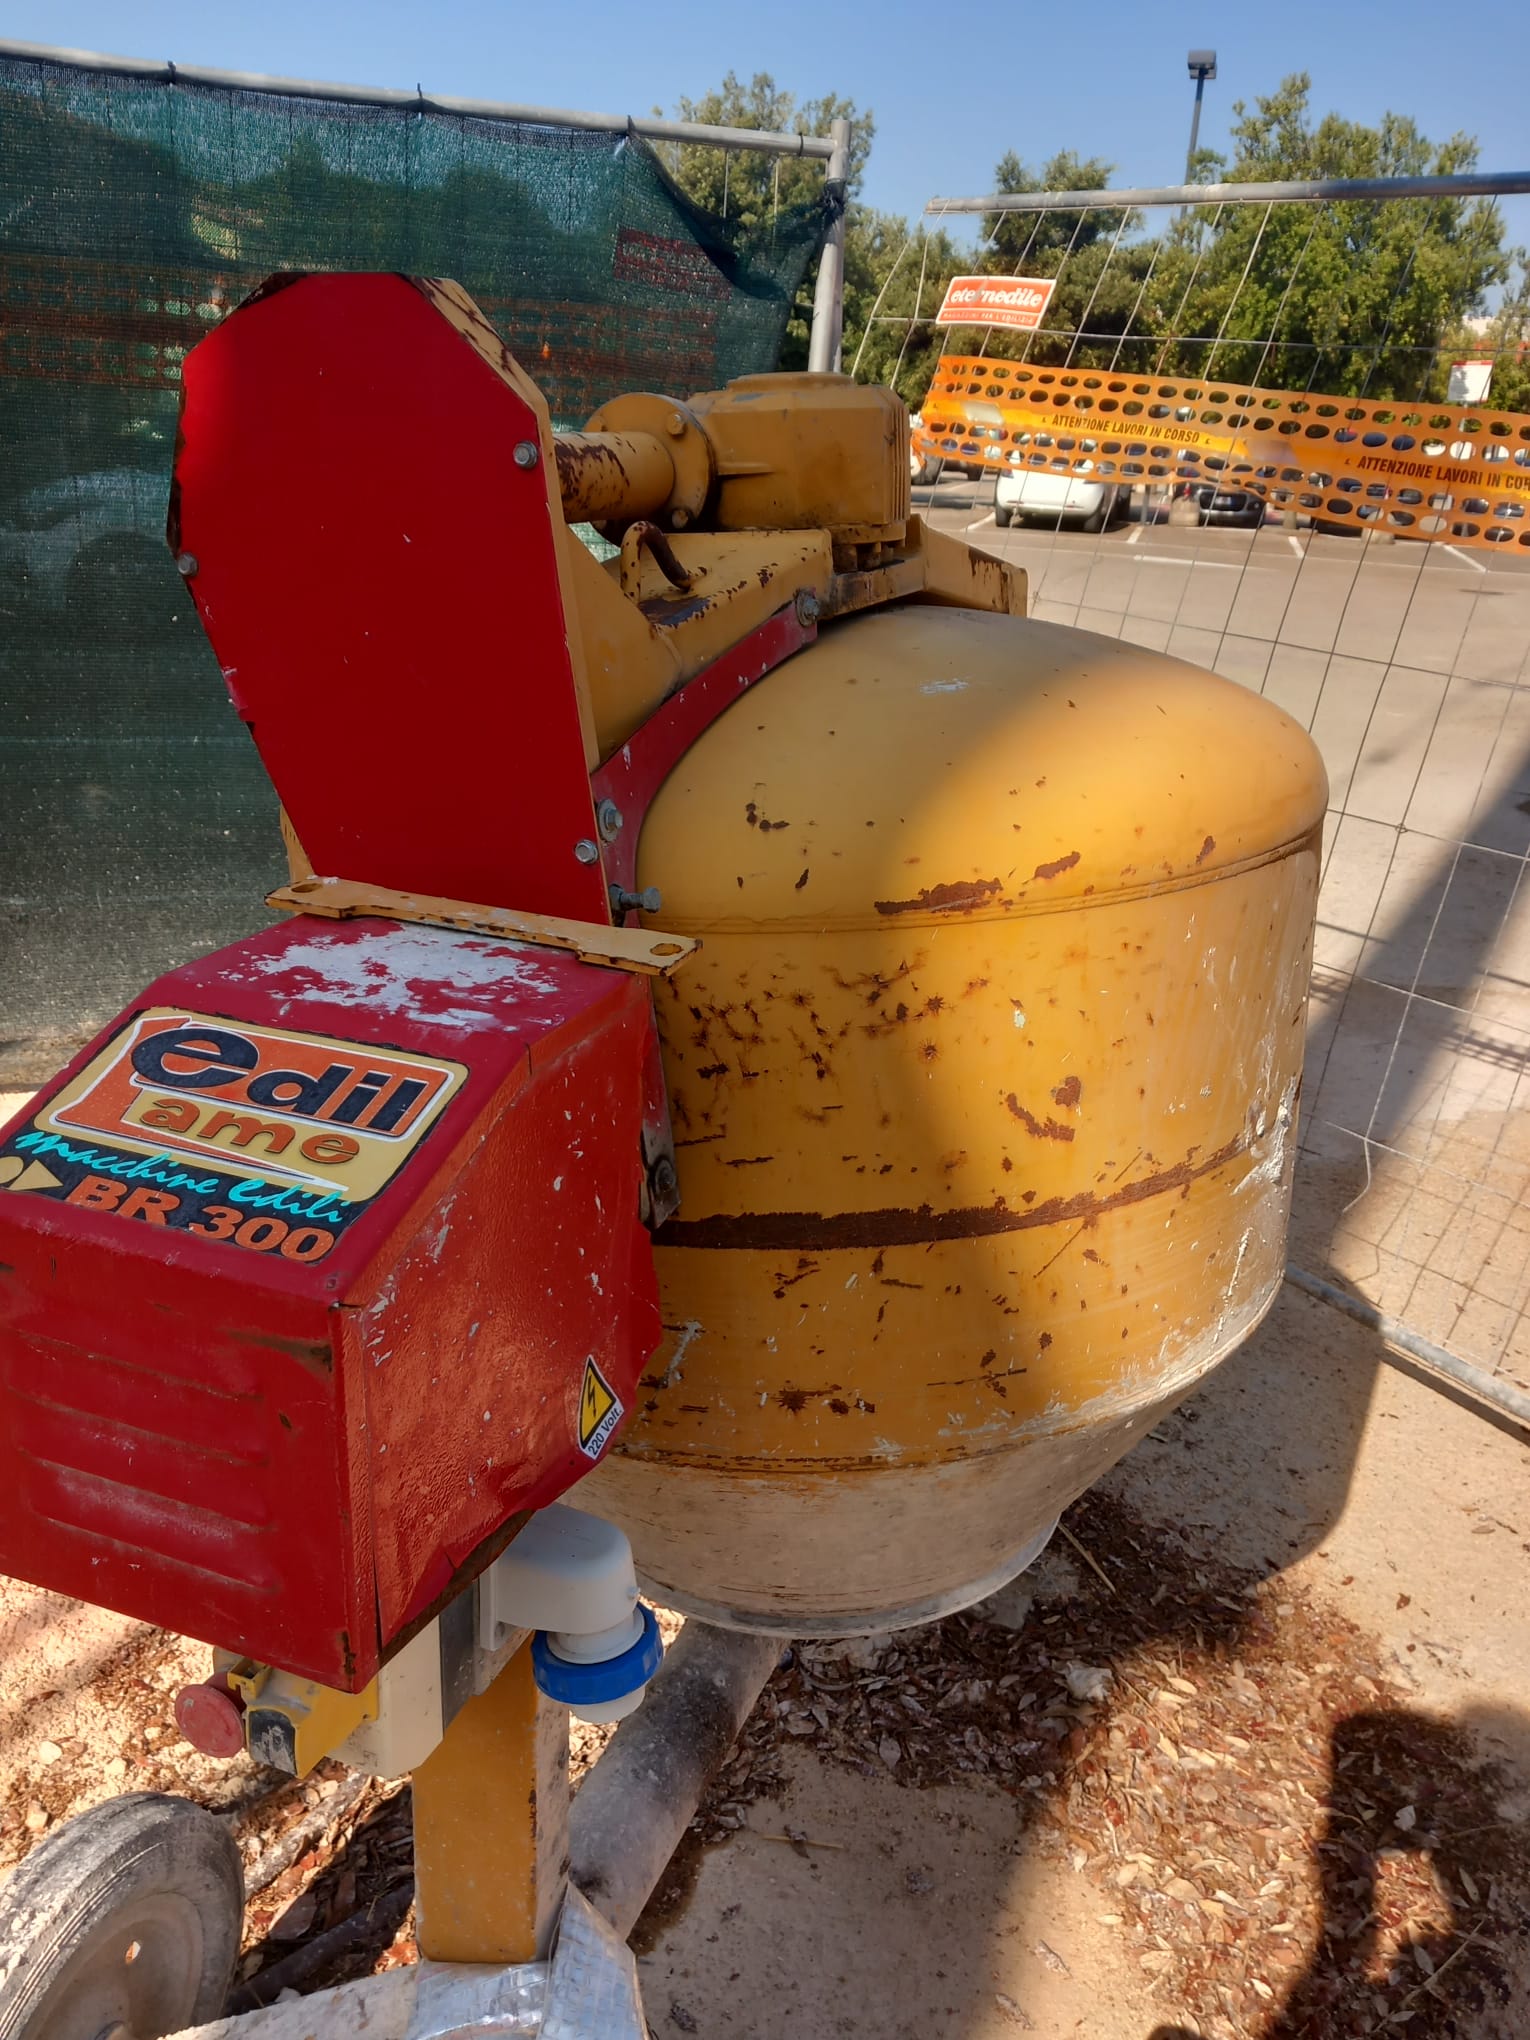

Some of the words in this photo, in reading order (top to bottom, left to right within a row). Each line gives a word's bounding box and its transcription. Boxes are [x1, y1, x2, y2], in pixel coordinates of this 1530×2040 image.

[1052, 414, 1109, 433] ATTENZIONE
[1112, 420, 1148, 436] LAVORI
[1150, 426, 1162, 438] IN
[1164, 428, 1201, 443] CORSO
[1357, 456, 1433, 479] ATTENZIONE
[1436, 467, 1483, 486] LAVORI
[1487, 472, 1501, 488] IN
[65, 1175, 181, 1227] BR
[188, 1205, 335, 1262] 300
[588, 1432, 605, 1456] 220
